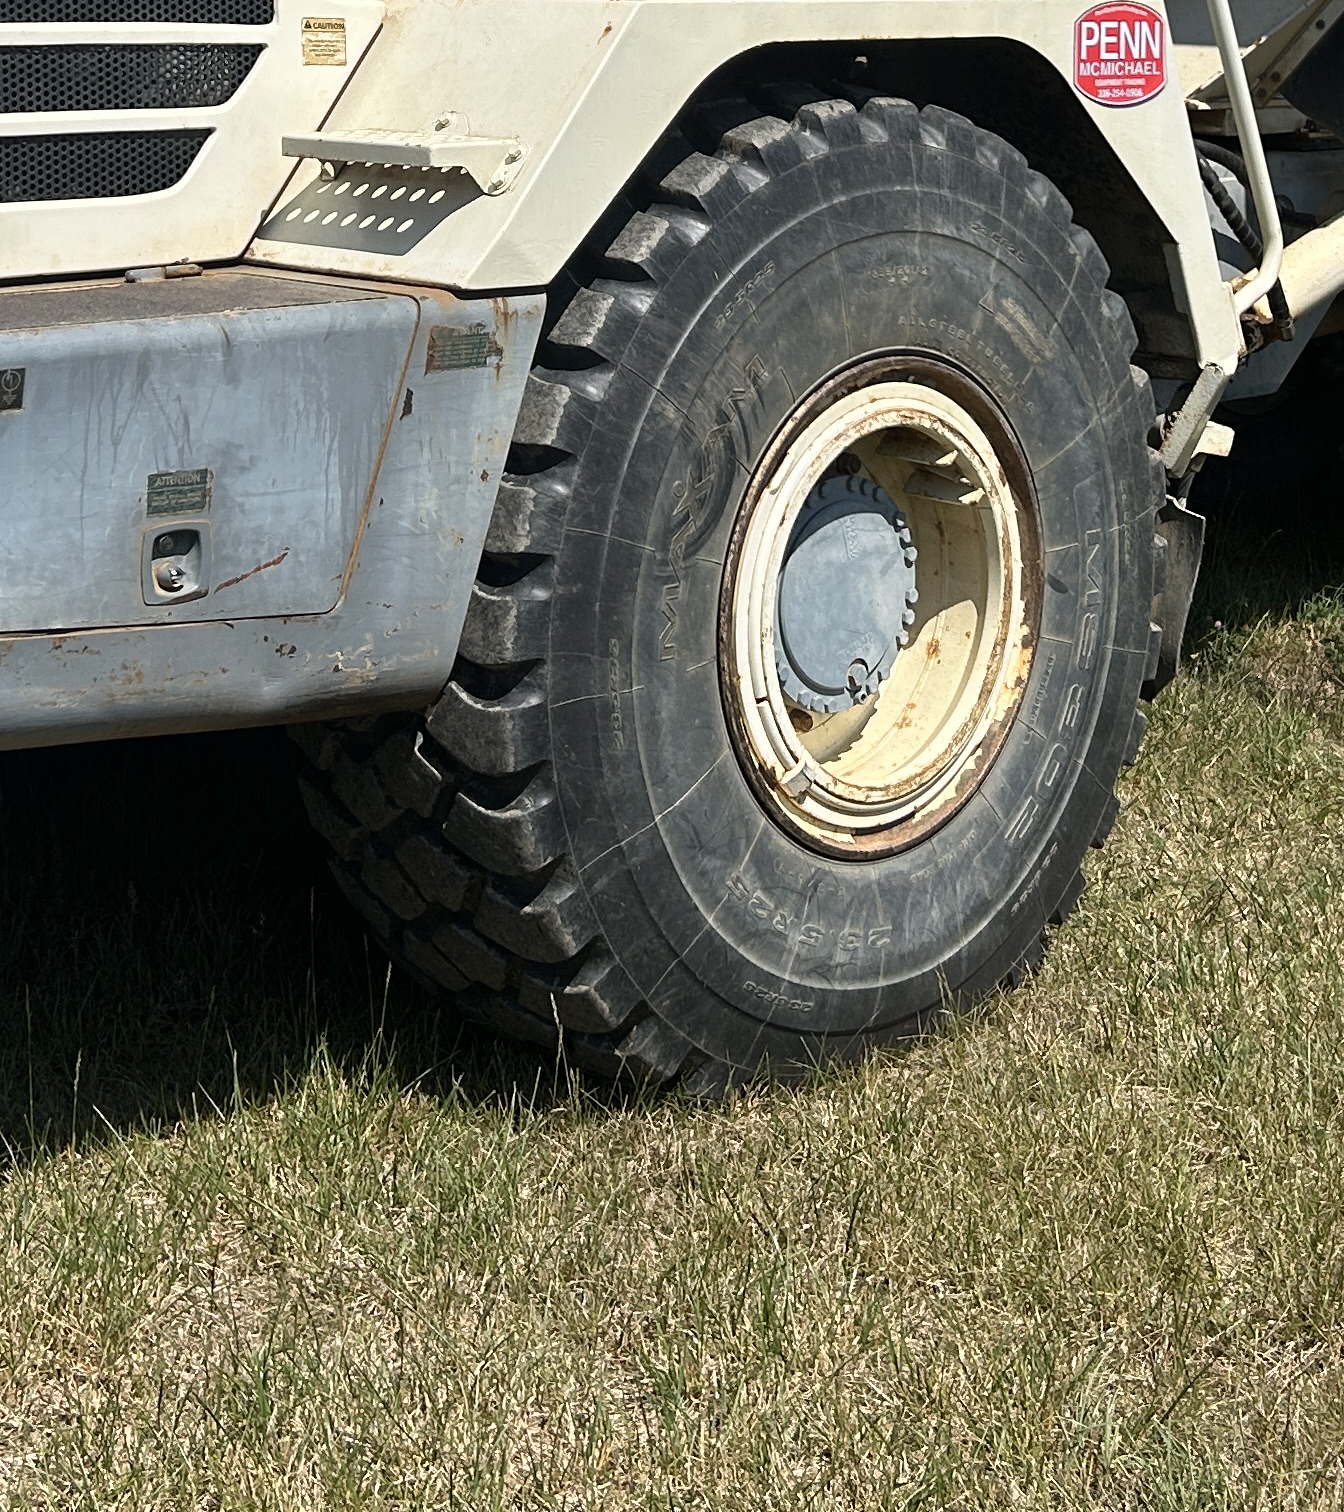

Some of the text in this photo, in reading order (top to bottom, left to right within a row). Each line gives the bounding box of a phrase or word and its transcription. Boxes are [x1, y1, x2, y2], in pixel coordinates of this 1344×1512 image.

[312, 22, 345, 30] CAUTION
[1080, 20, 1161, 60] PENN
[1079, 61, 1161, 77] MCMICHAEL
[155, 472, 201, 486] ATTENTION
